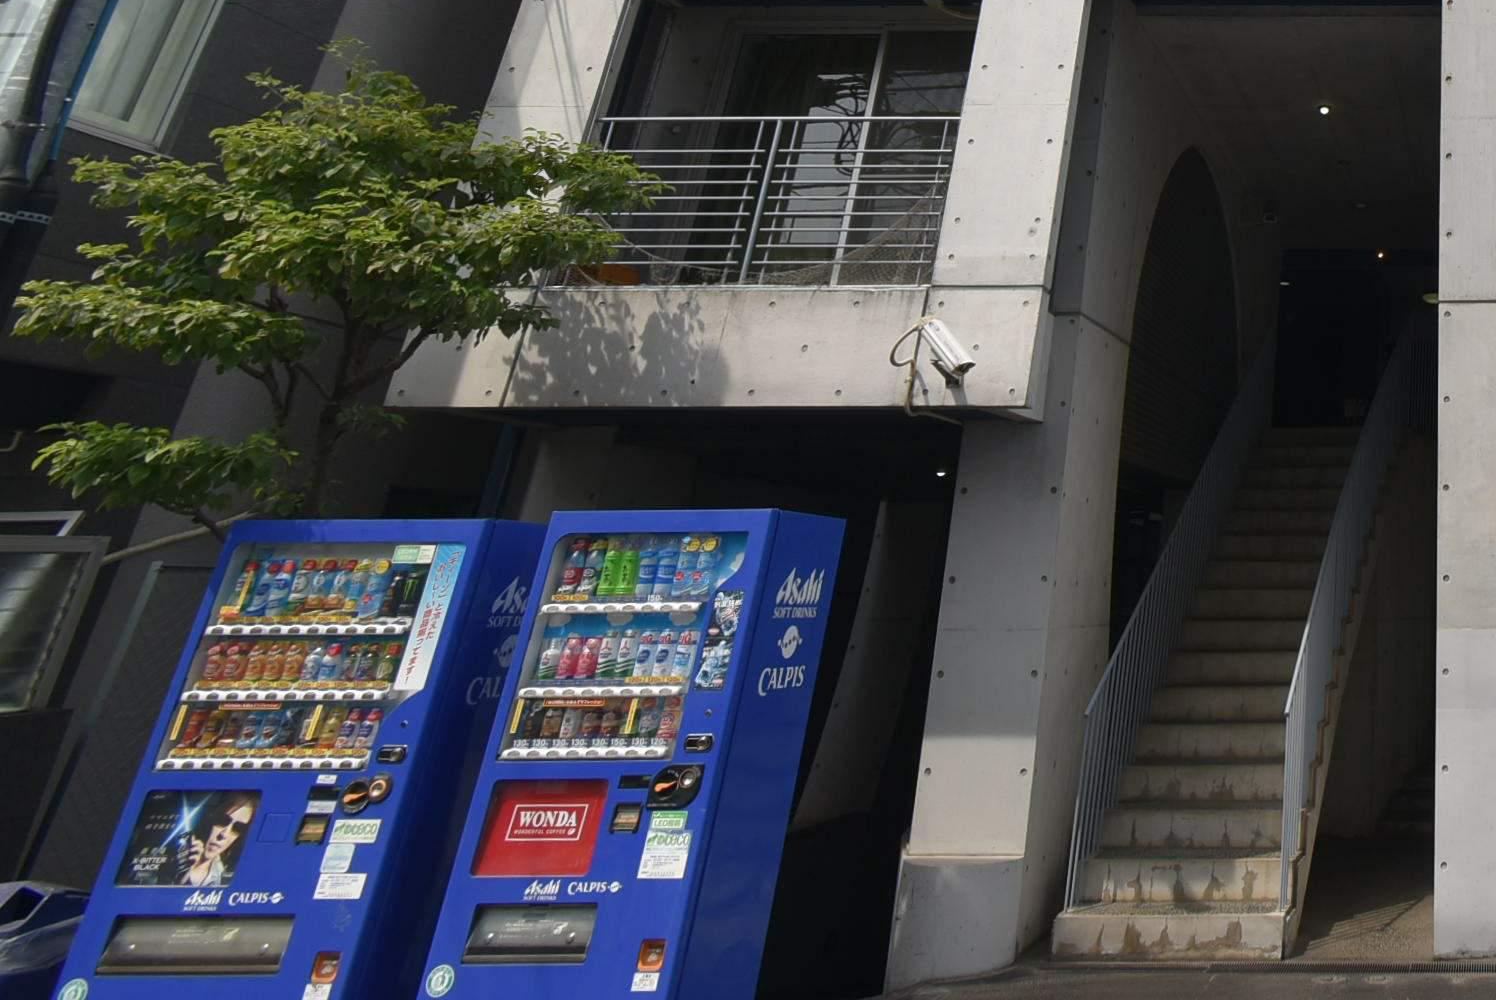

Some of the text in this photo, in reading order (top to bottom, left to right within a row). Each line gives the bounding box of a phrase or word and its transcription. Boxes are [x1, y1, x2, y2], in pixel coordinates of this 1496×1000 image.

[776, 567, 825, 605] Asahi
[772, 607, 817, 618] SOFT DRINKS
[758, 665, 806, 696] CALPIS
[520, 810, 577, 827] WONDA
[132, 864, 160, 872] BLACK
[523, 879, 608, 896] Asahi CALPIS
[184, 890, 269, 907] Asahi CALPIS
